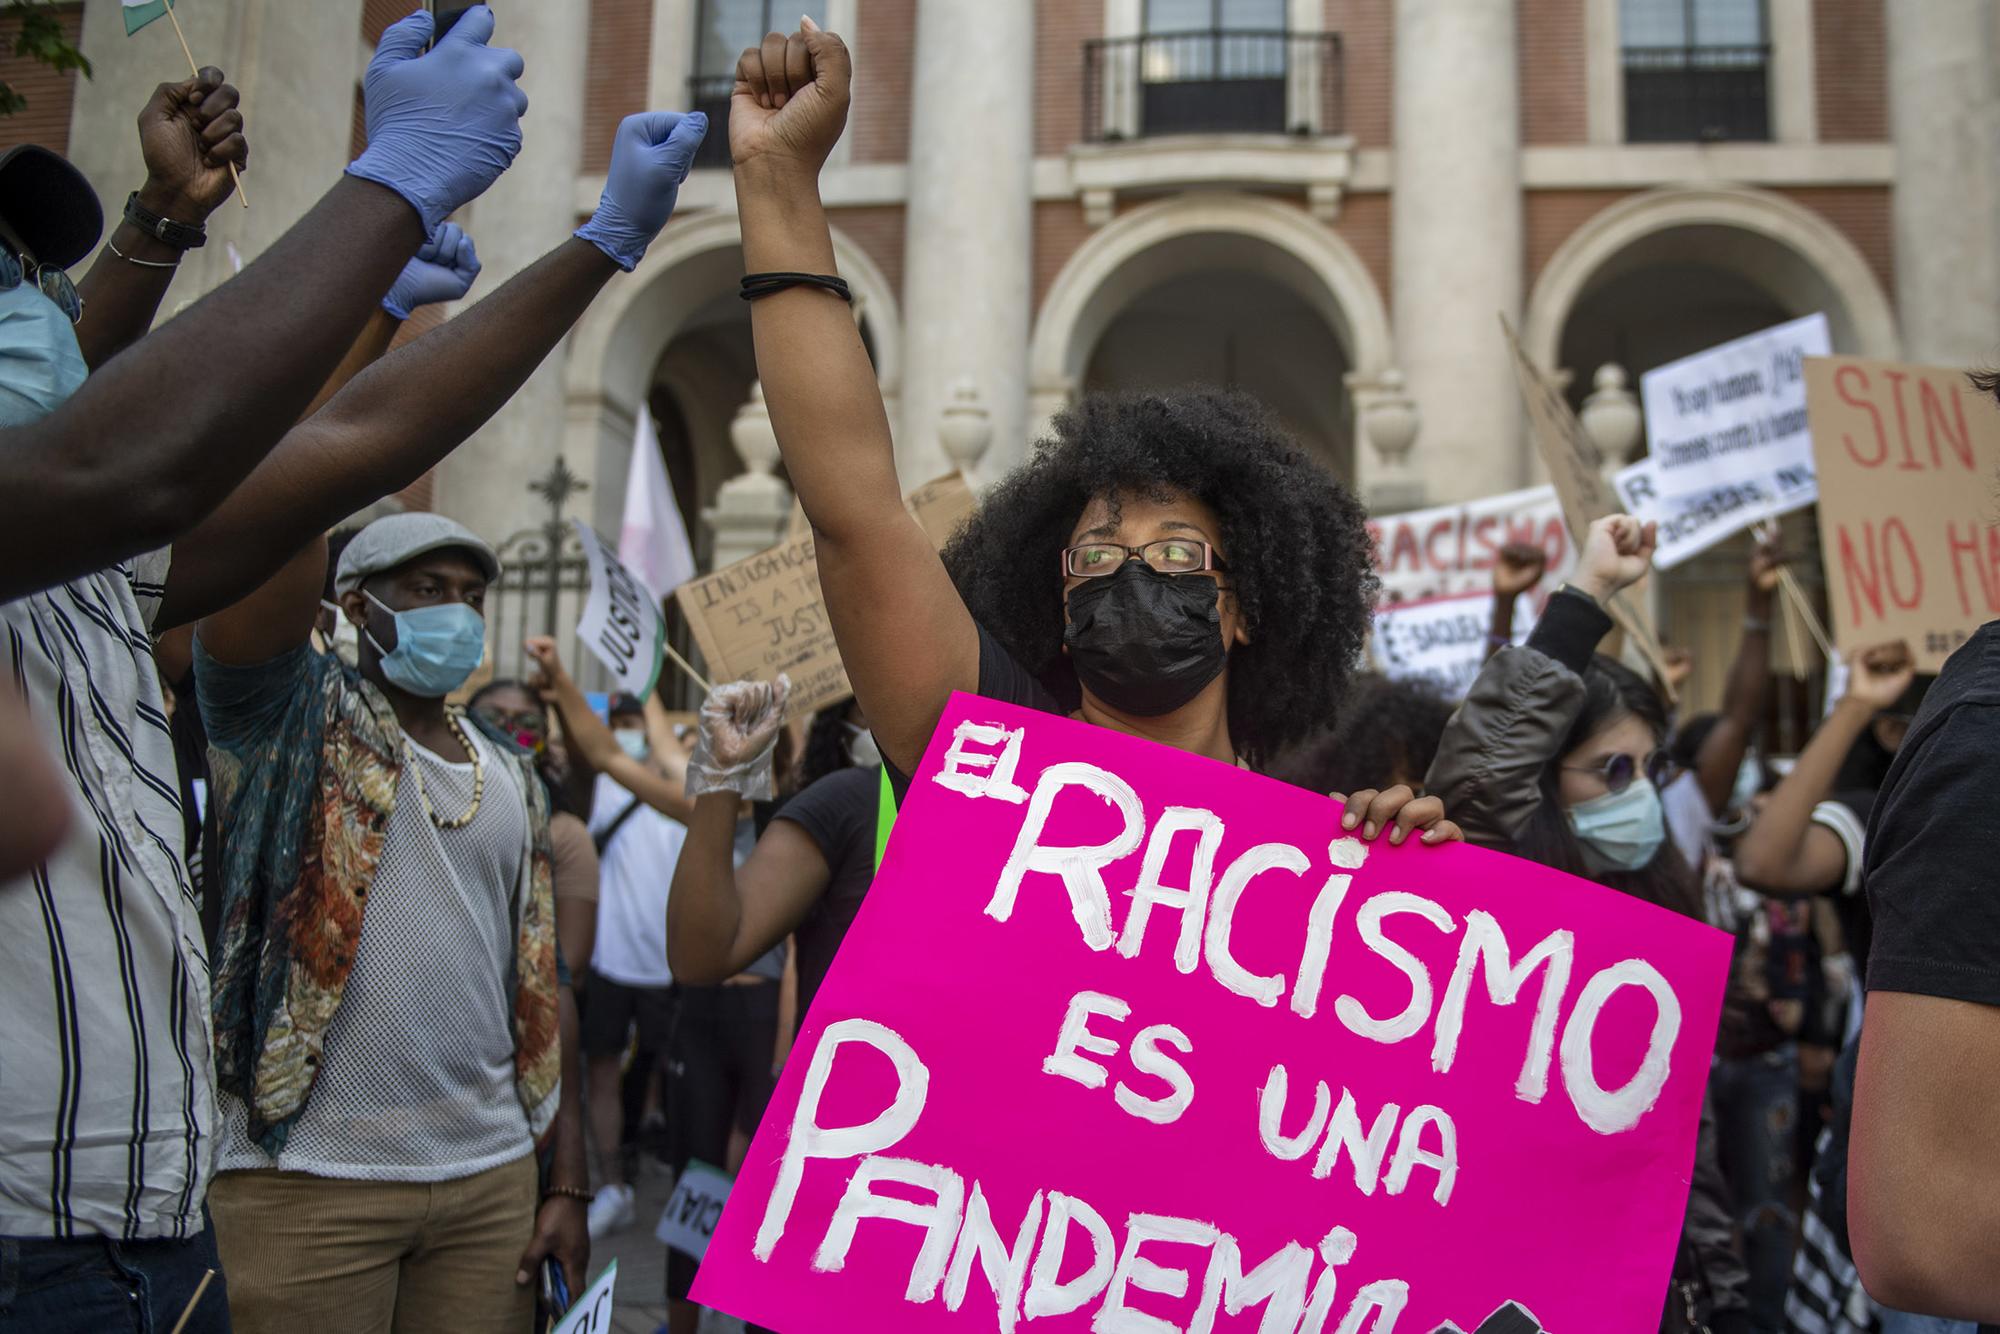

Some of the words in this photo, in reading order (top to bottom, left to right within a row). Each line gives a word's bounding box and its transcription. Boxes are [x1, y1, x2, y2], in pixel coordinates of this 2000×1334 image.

[1833, 364, 1977, 473] SIN
[699, 540, 816, 609] INJUSTICE
[726, 597, 762, 626] IS
[772, 587, 788, 608] A
[1836, 514, 1925, 629] NO
[931, 719, 1031, 805] EL
[1041, 989, 1196, 1126] ES
[1257, 1062, 1460, 1208] UNA
